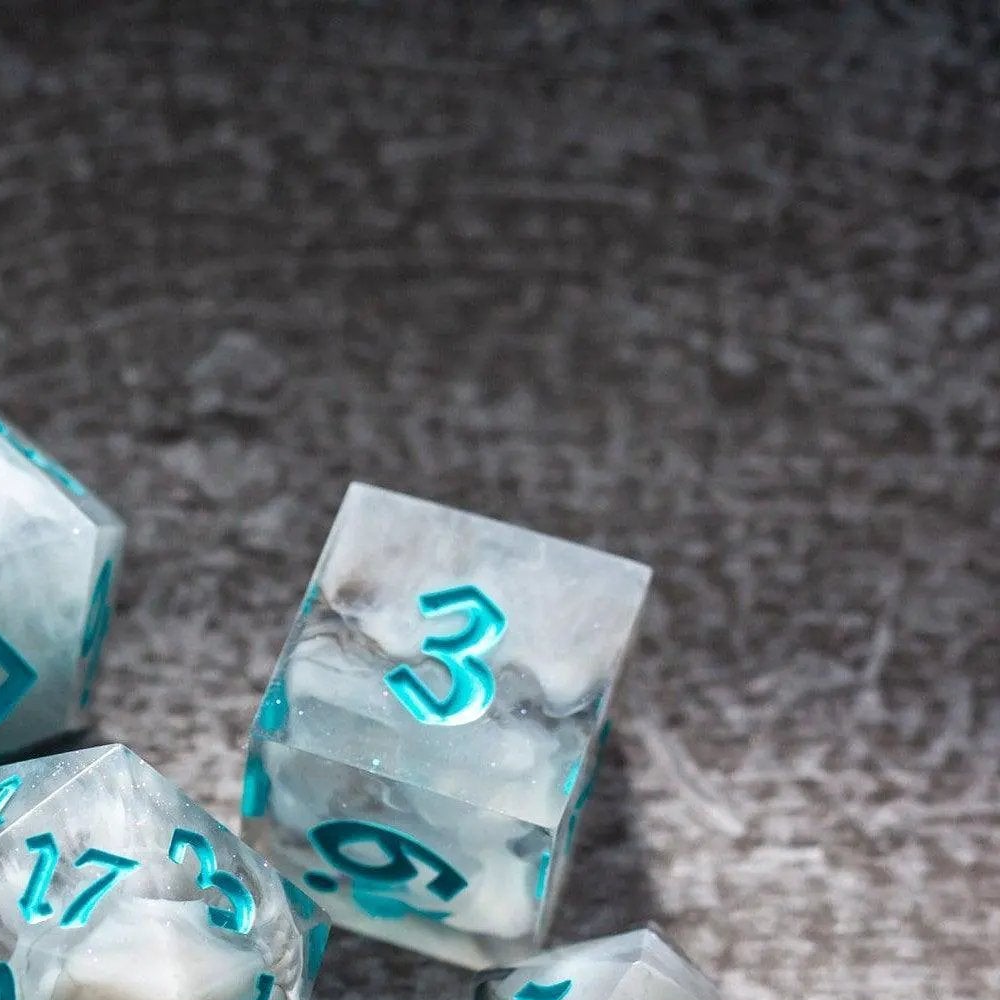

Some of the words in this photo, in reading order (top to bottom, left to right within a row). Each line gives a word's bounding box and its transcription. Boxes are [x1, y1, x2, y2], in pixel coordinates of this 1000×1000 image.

[384, 584, 508, 726] 3
[18, 832, 140, 927] 17
[168, 828, 256, 935] 3
